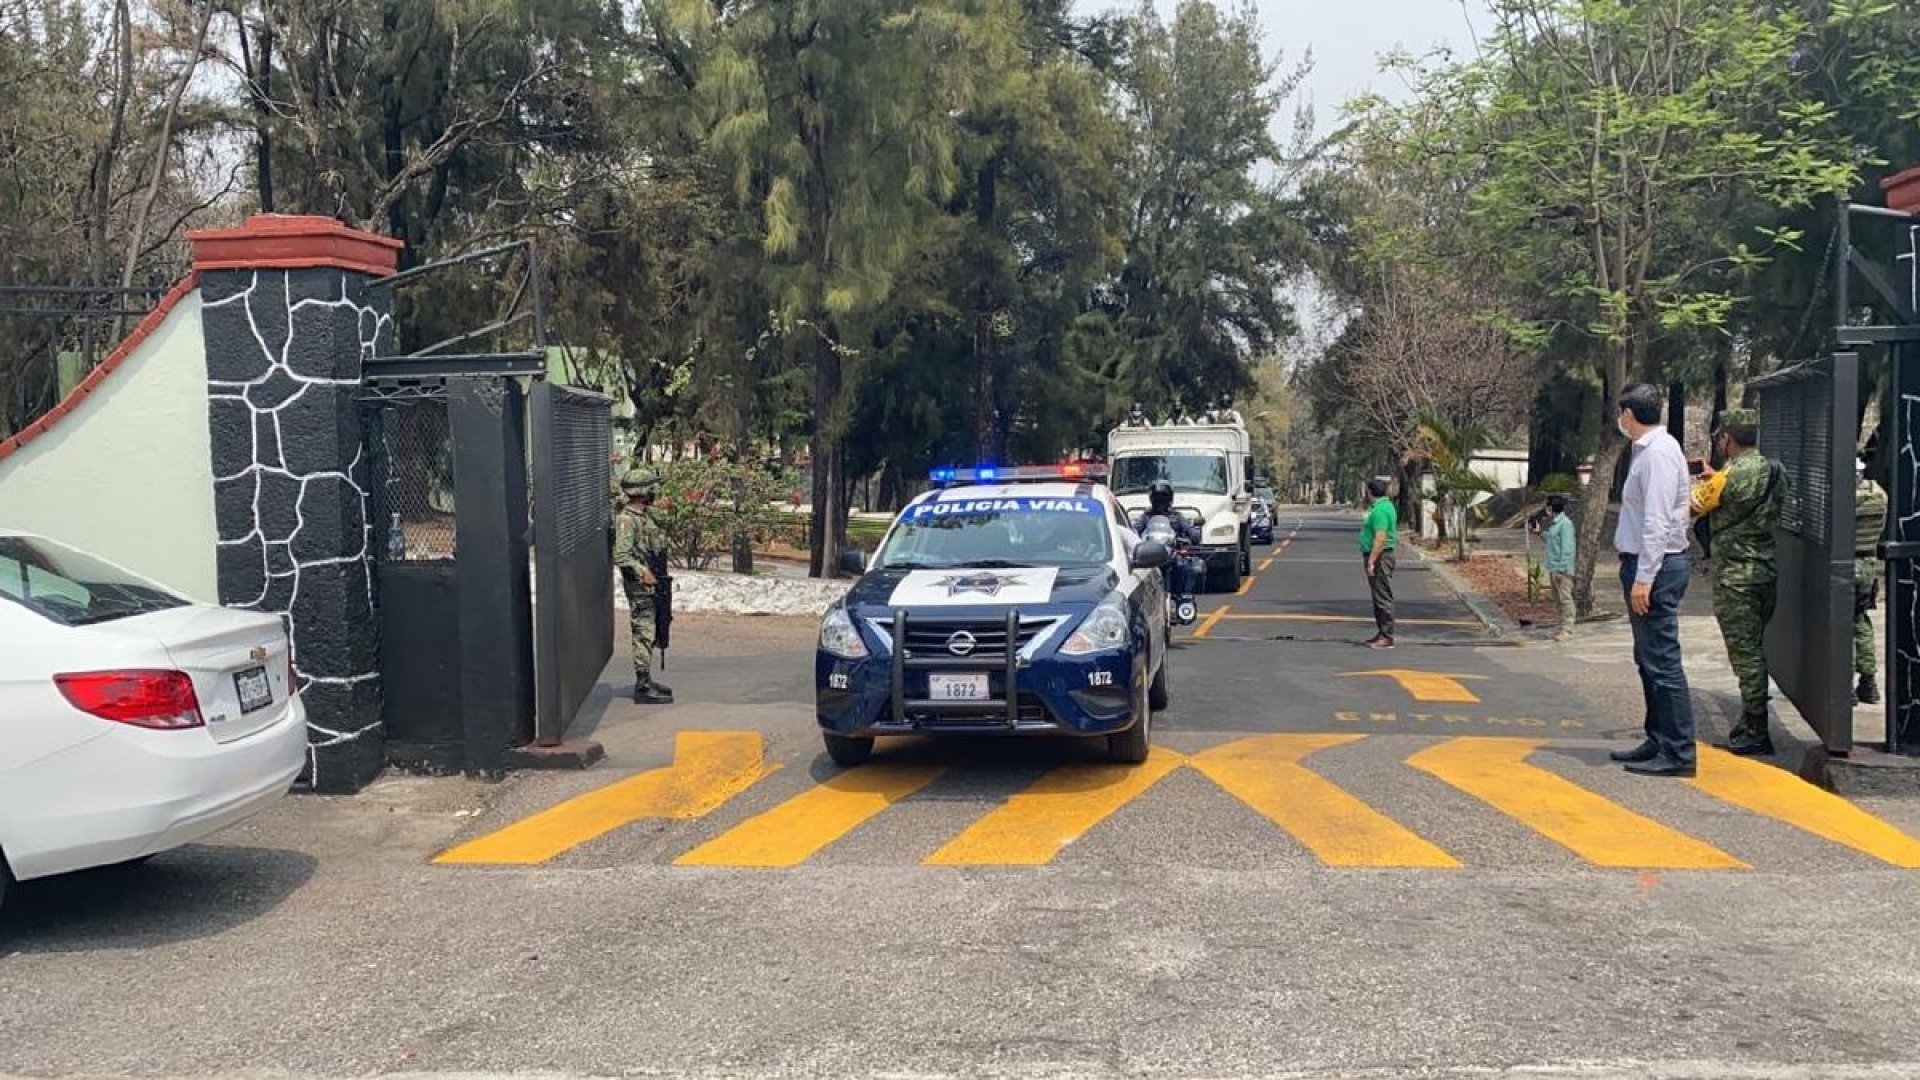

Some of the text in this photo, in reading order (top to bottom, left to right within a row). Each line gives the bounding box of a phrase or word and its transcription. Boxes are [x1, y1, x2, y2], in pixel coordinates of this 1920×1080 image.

[913, 499, 1090, 518] POLICIA VIAL
[828, 673, 848, 689] 1872
[1087, 671, 1113, 687] 1872
[945, 682, 977, 697] 1872
